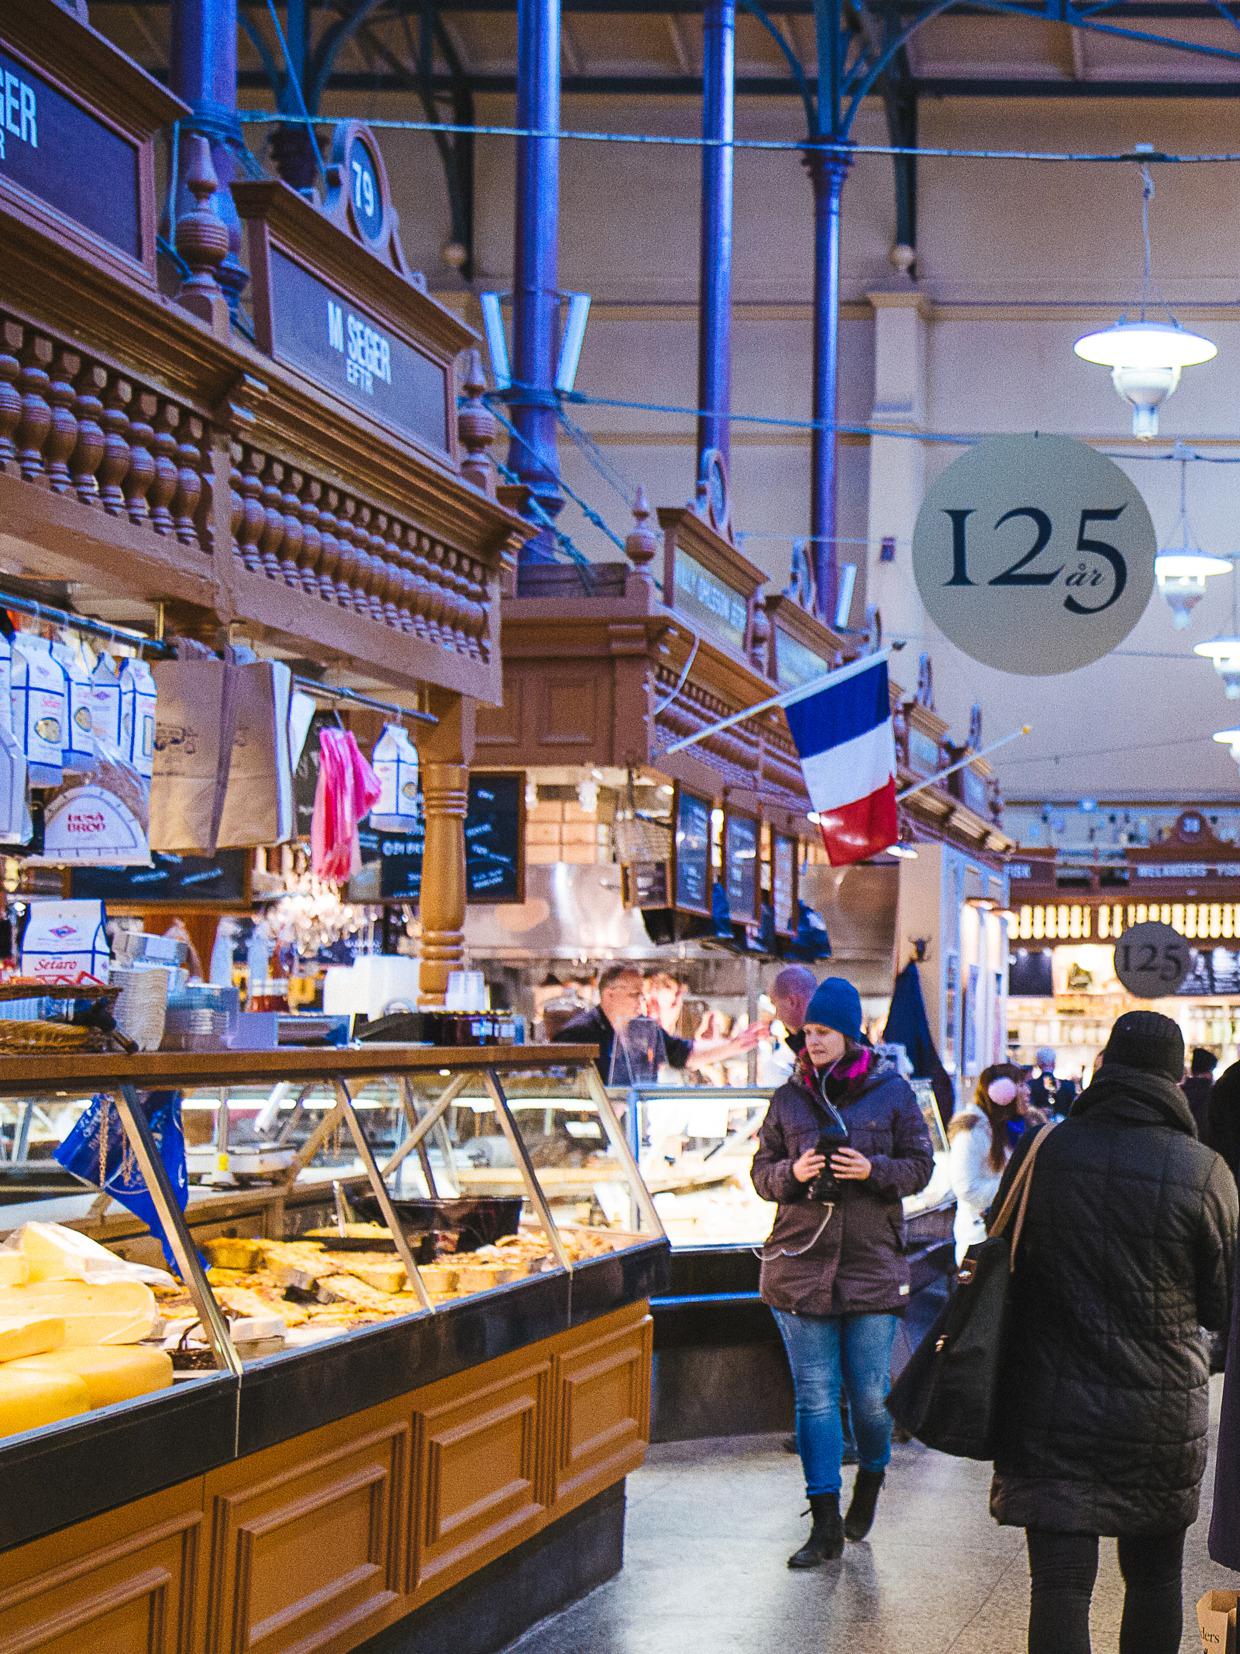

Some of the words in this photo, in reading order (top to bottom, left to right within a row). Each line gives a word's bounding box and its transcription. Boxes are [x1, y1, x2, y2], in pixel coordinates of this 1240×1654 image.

[0, 66, 38, 148] ER
[352, 160, 374, 217] 79
[328, 300, 344, 353] M
[348, 314, 392, 384] SEGER
[940, 502, 1128, 616] 125
[1065, 562, 1104, 587] år
[34, 959, 77, 971] Setaro
[1122, 944, 1182, 981] 125
